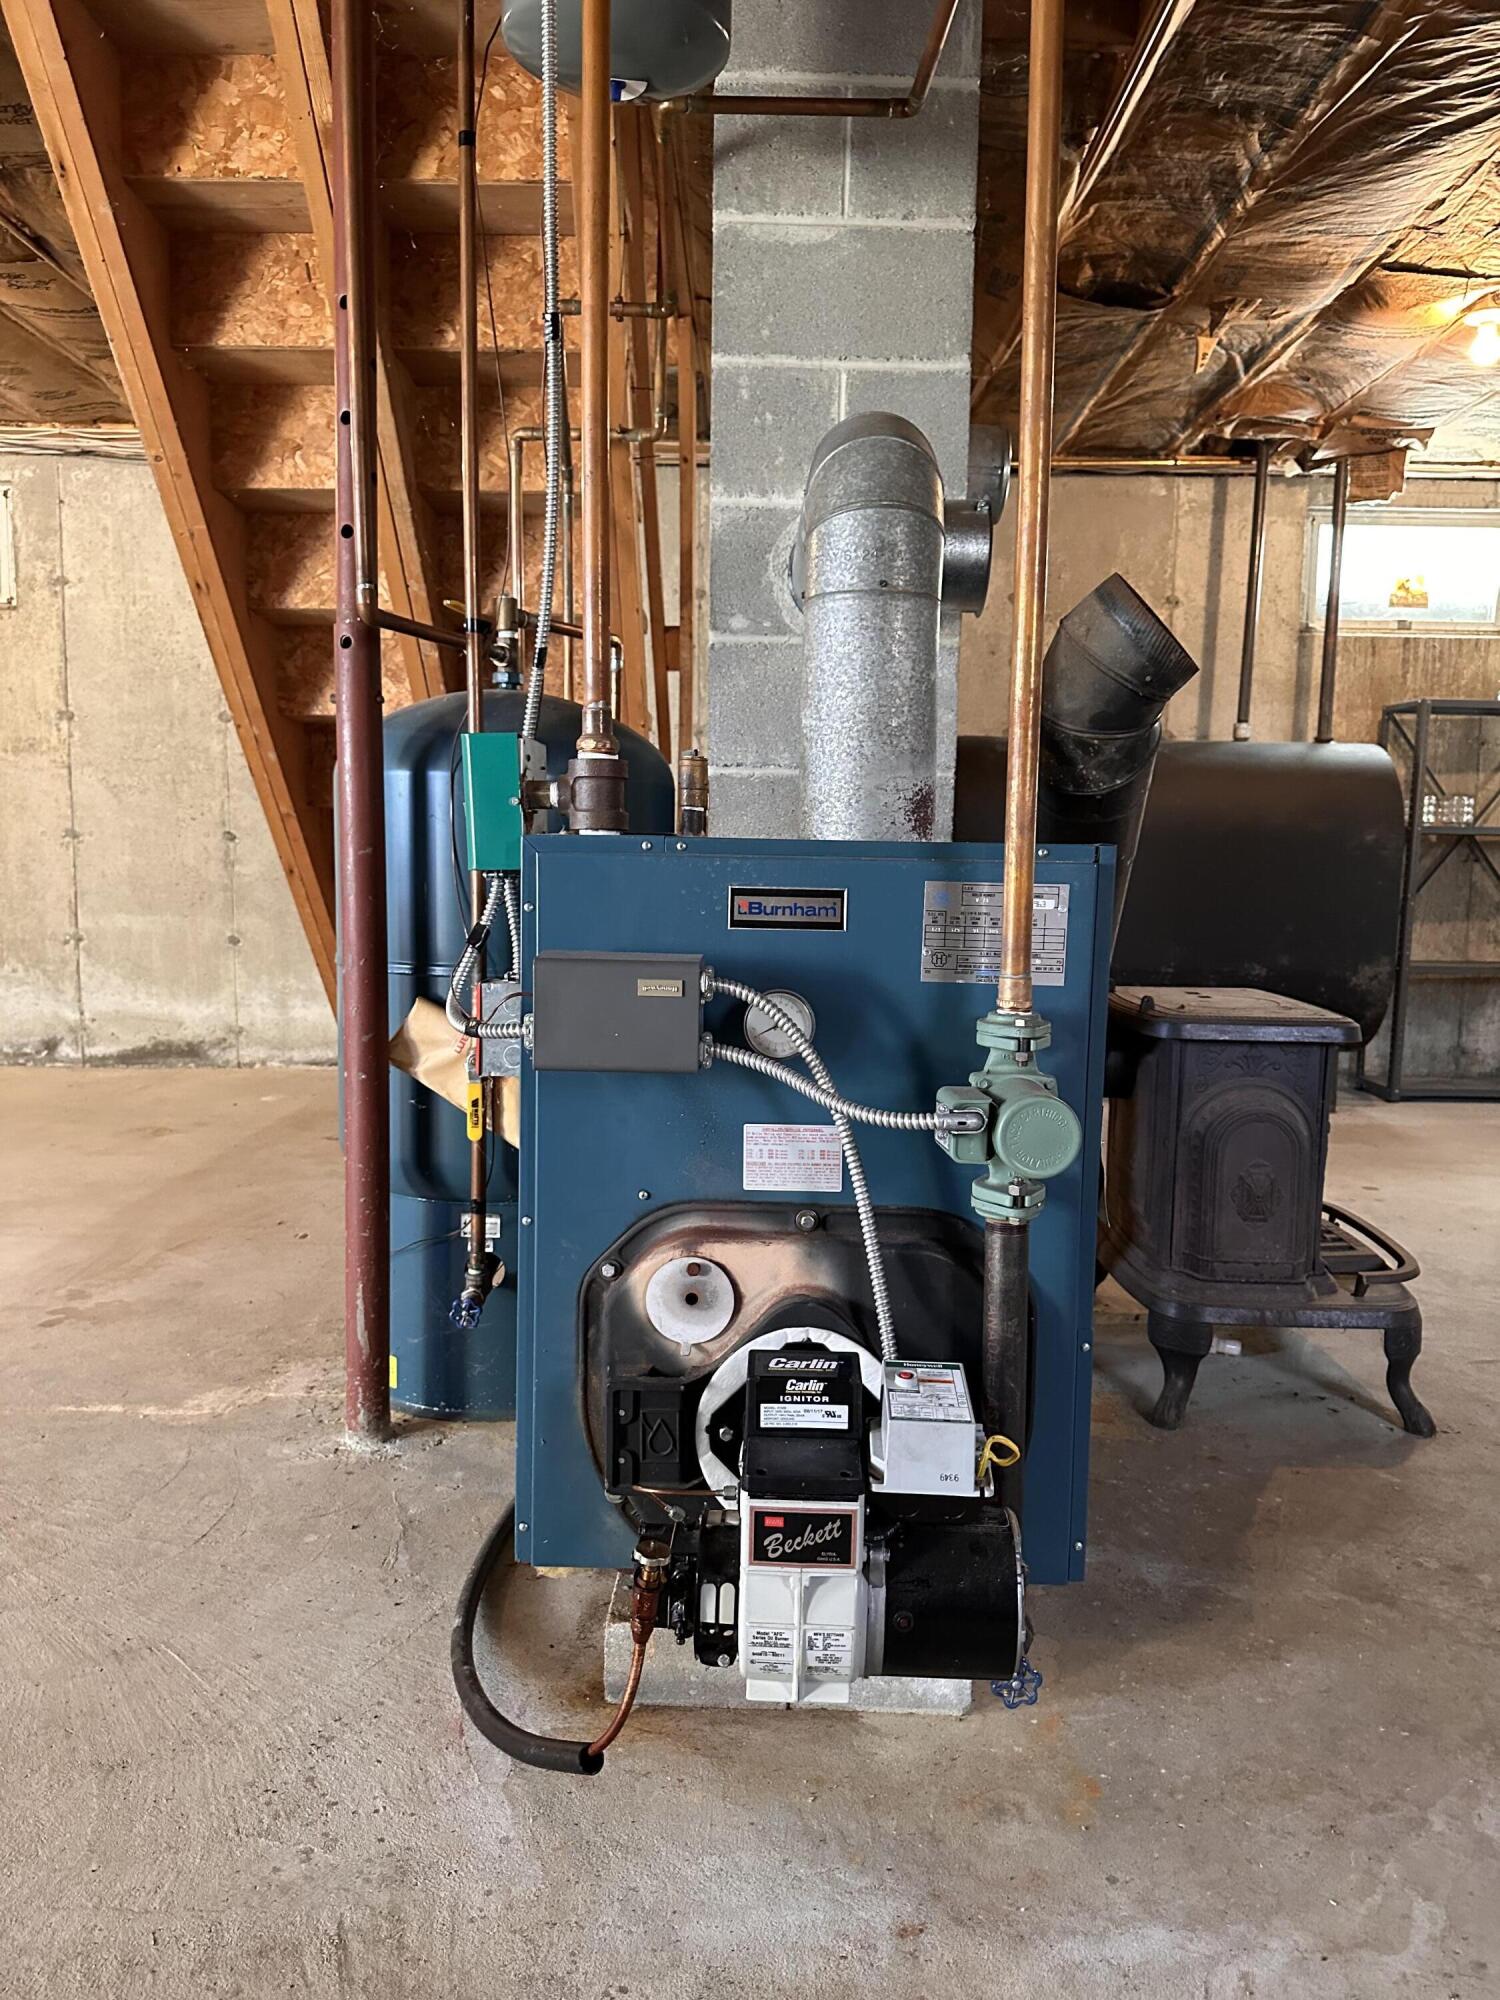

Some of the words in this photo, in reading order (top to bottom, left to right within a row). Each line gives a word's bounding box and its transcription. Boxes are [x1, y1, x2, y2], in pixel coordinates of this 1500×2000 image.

[748, 901, 837, 918] Burnham
[768, 1357, 839, 1370] Carlin
[785, 1379, 825, 1391] Carlin
[779, 1395, 830, 1403] IGNITOR
[763, 1518, 843, 1559] Beckett
